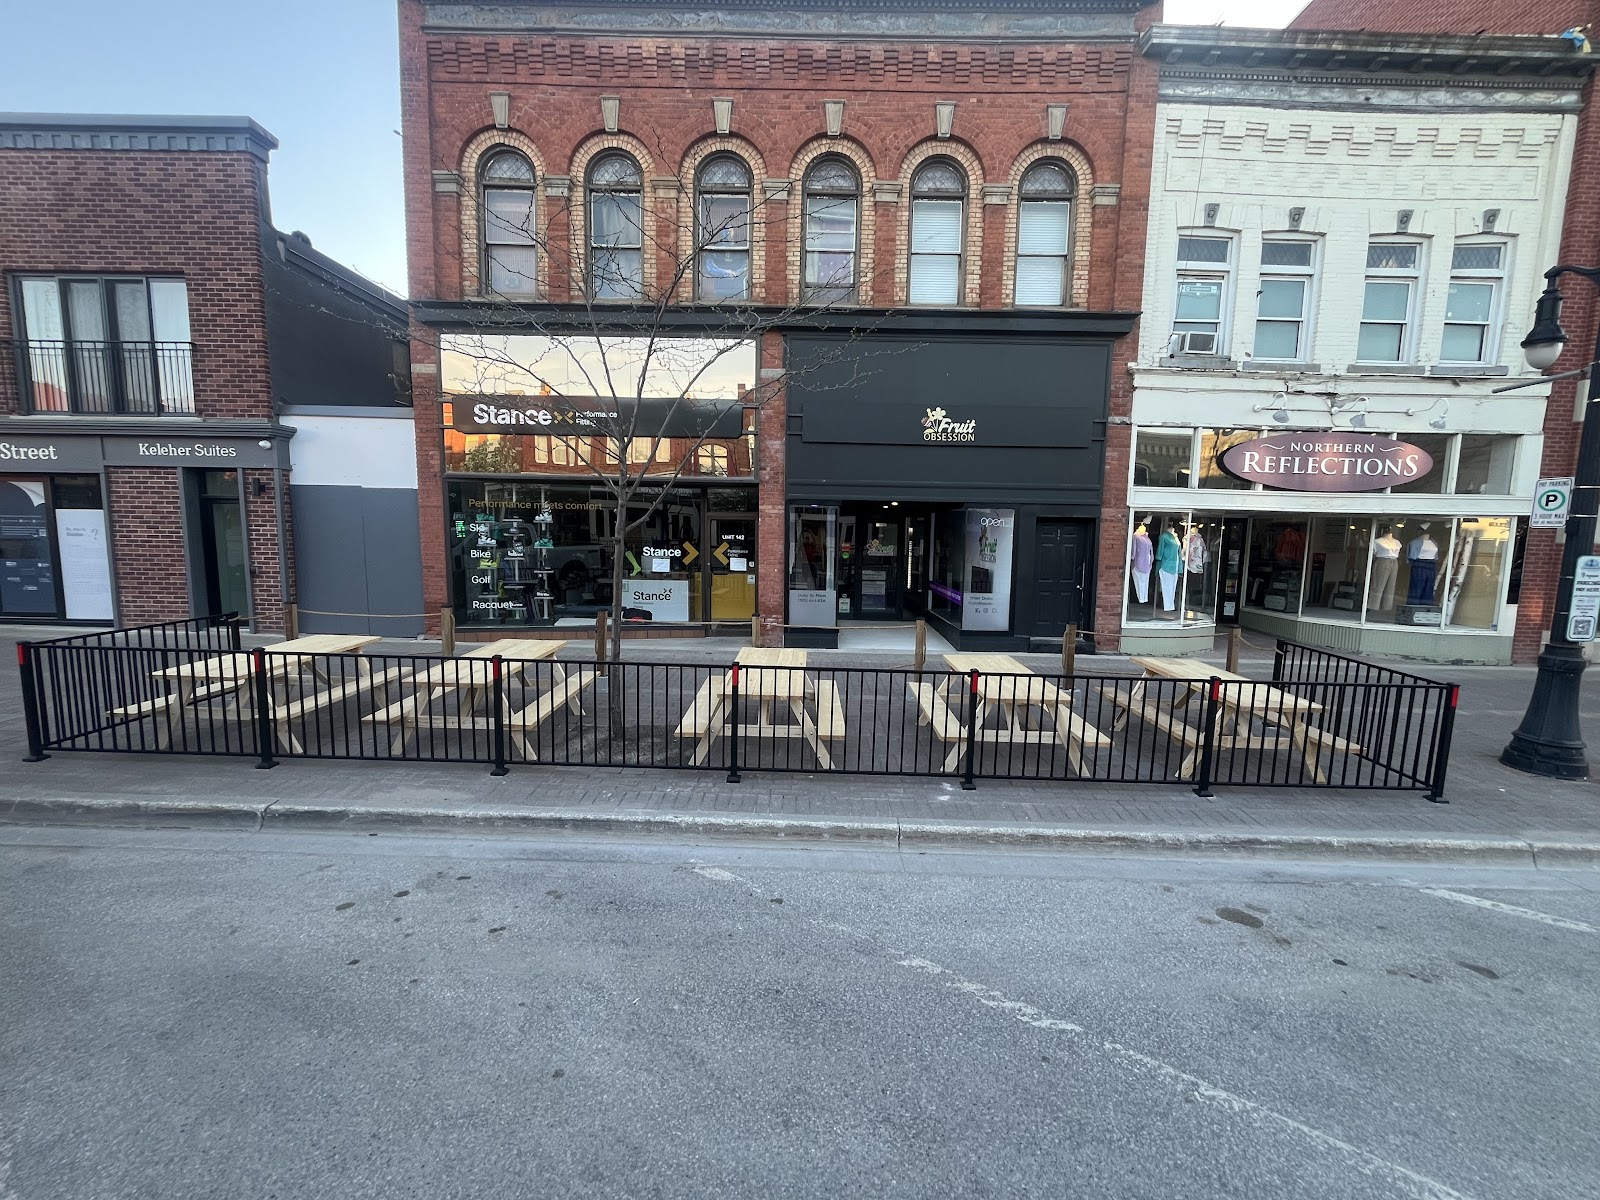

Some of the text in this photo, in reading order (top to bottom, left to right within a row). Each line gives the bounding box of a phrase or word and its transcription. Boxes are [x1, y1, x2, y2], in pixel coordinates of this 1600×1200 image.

[473, 403, 618, 425] Stance Pformace
[938, 417, 977, 434] Fruit
[923, 432, 975, 442] OBSESSION
[0, 442, 58, 460] Street
[138, 442, 237, 457] Keleher Suites
[1290, 442, 1375, 454] NORTHERN
[1242, 451, 1418, 477] REFLECTIONS
[533, 501, 564, 510] mets
[1545, 494, 1558, 507] P
[469, 523, 483, 532] Sk
[980, 517, 1005, 528] open
[470, 549, 491, 558] Bike
[642, 546, 681, 557] Stance
[471, 575, 491, 584] Golf
[633, 590, 672, 601] Stance
[472, 600, 513, 610] Racquet
